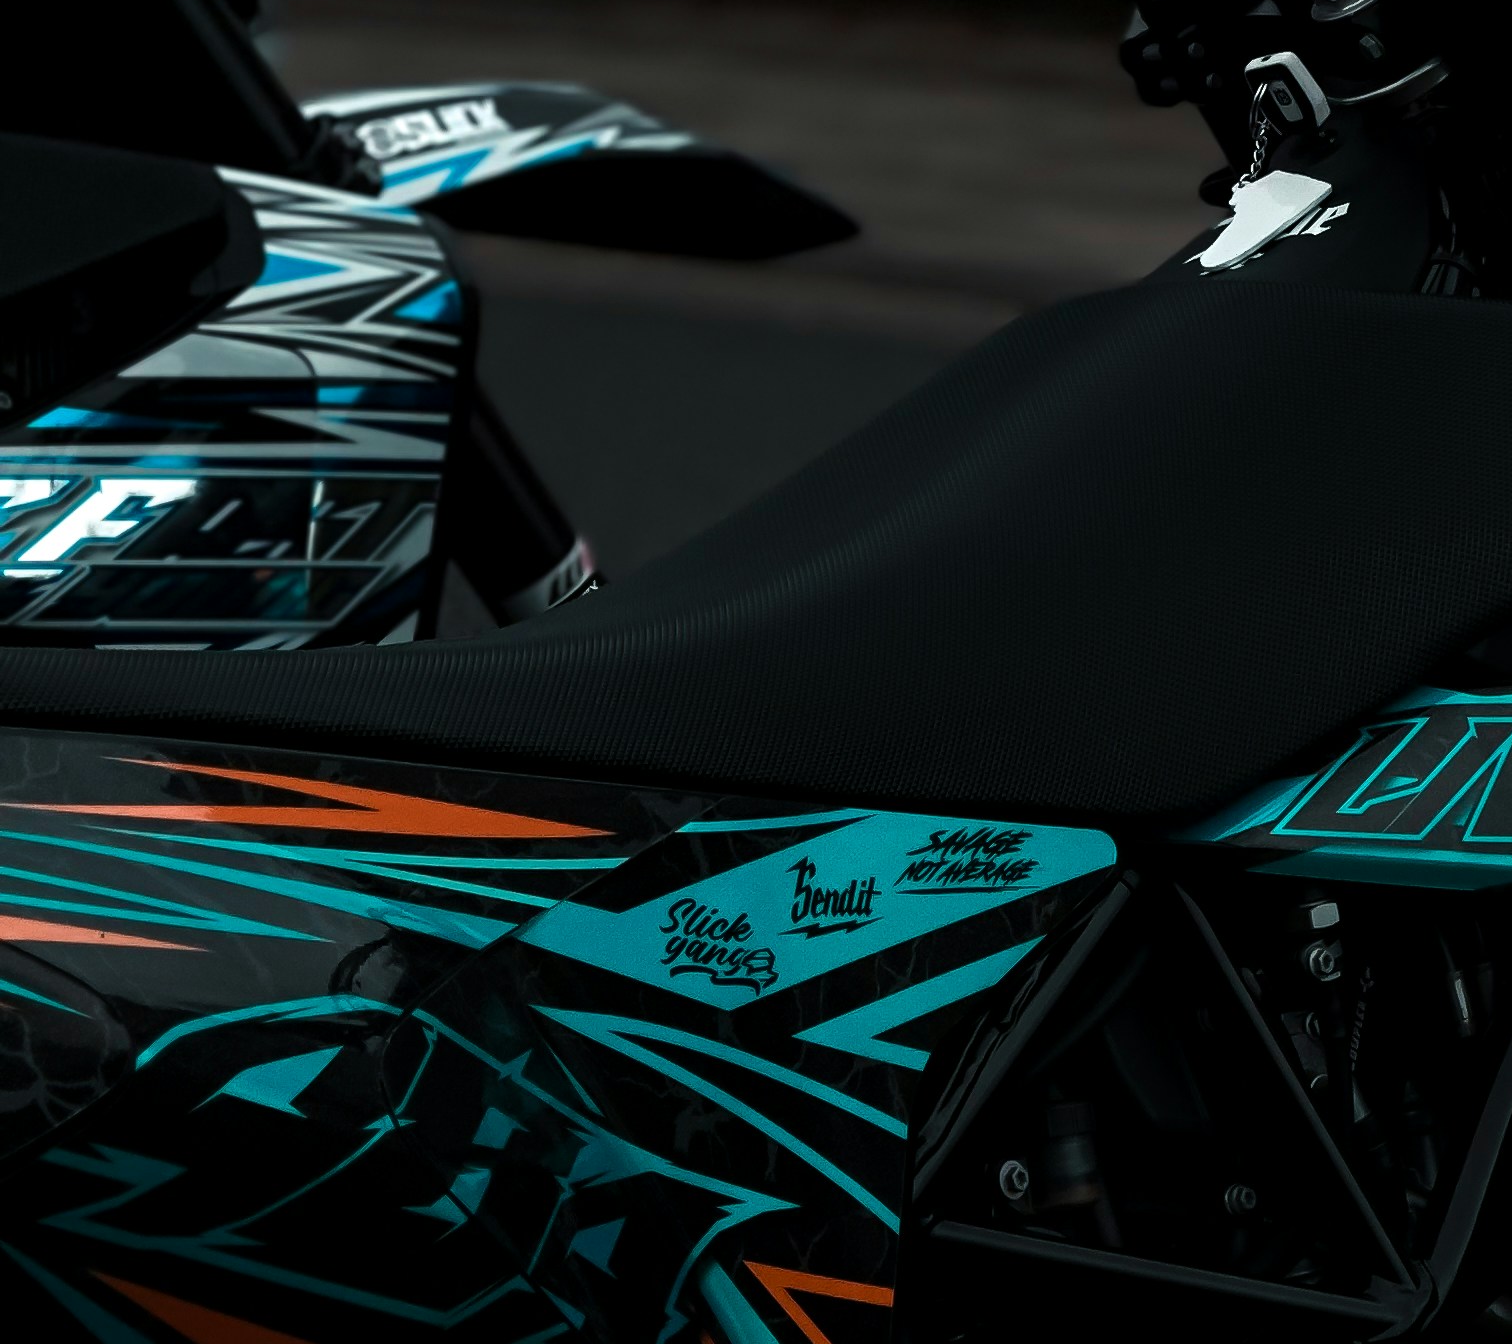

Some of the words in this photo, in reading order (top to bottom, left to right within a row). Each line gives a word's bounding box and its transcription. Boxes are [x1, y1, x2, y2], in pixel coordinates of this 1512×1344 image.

[905, 826, 1034, 861] SAVAGE
[893, 857, 951, 887] NOT
[936, 858, 1042, 887] AVERAGE
[659, 898, 755, 943] Slick
